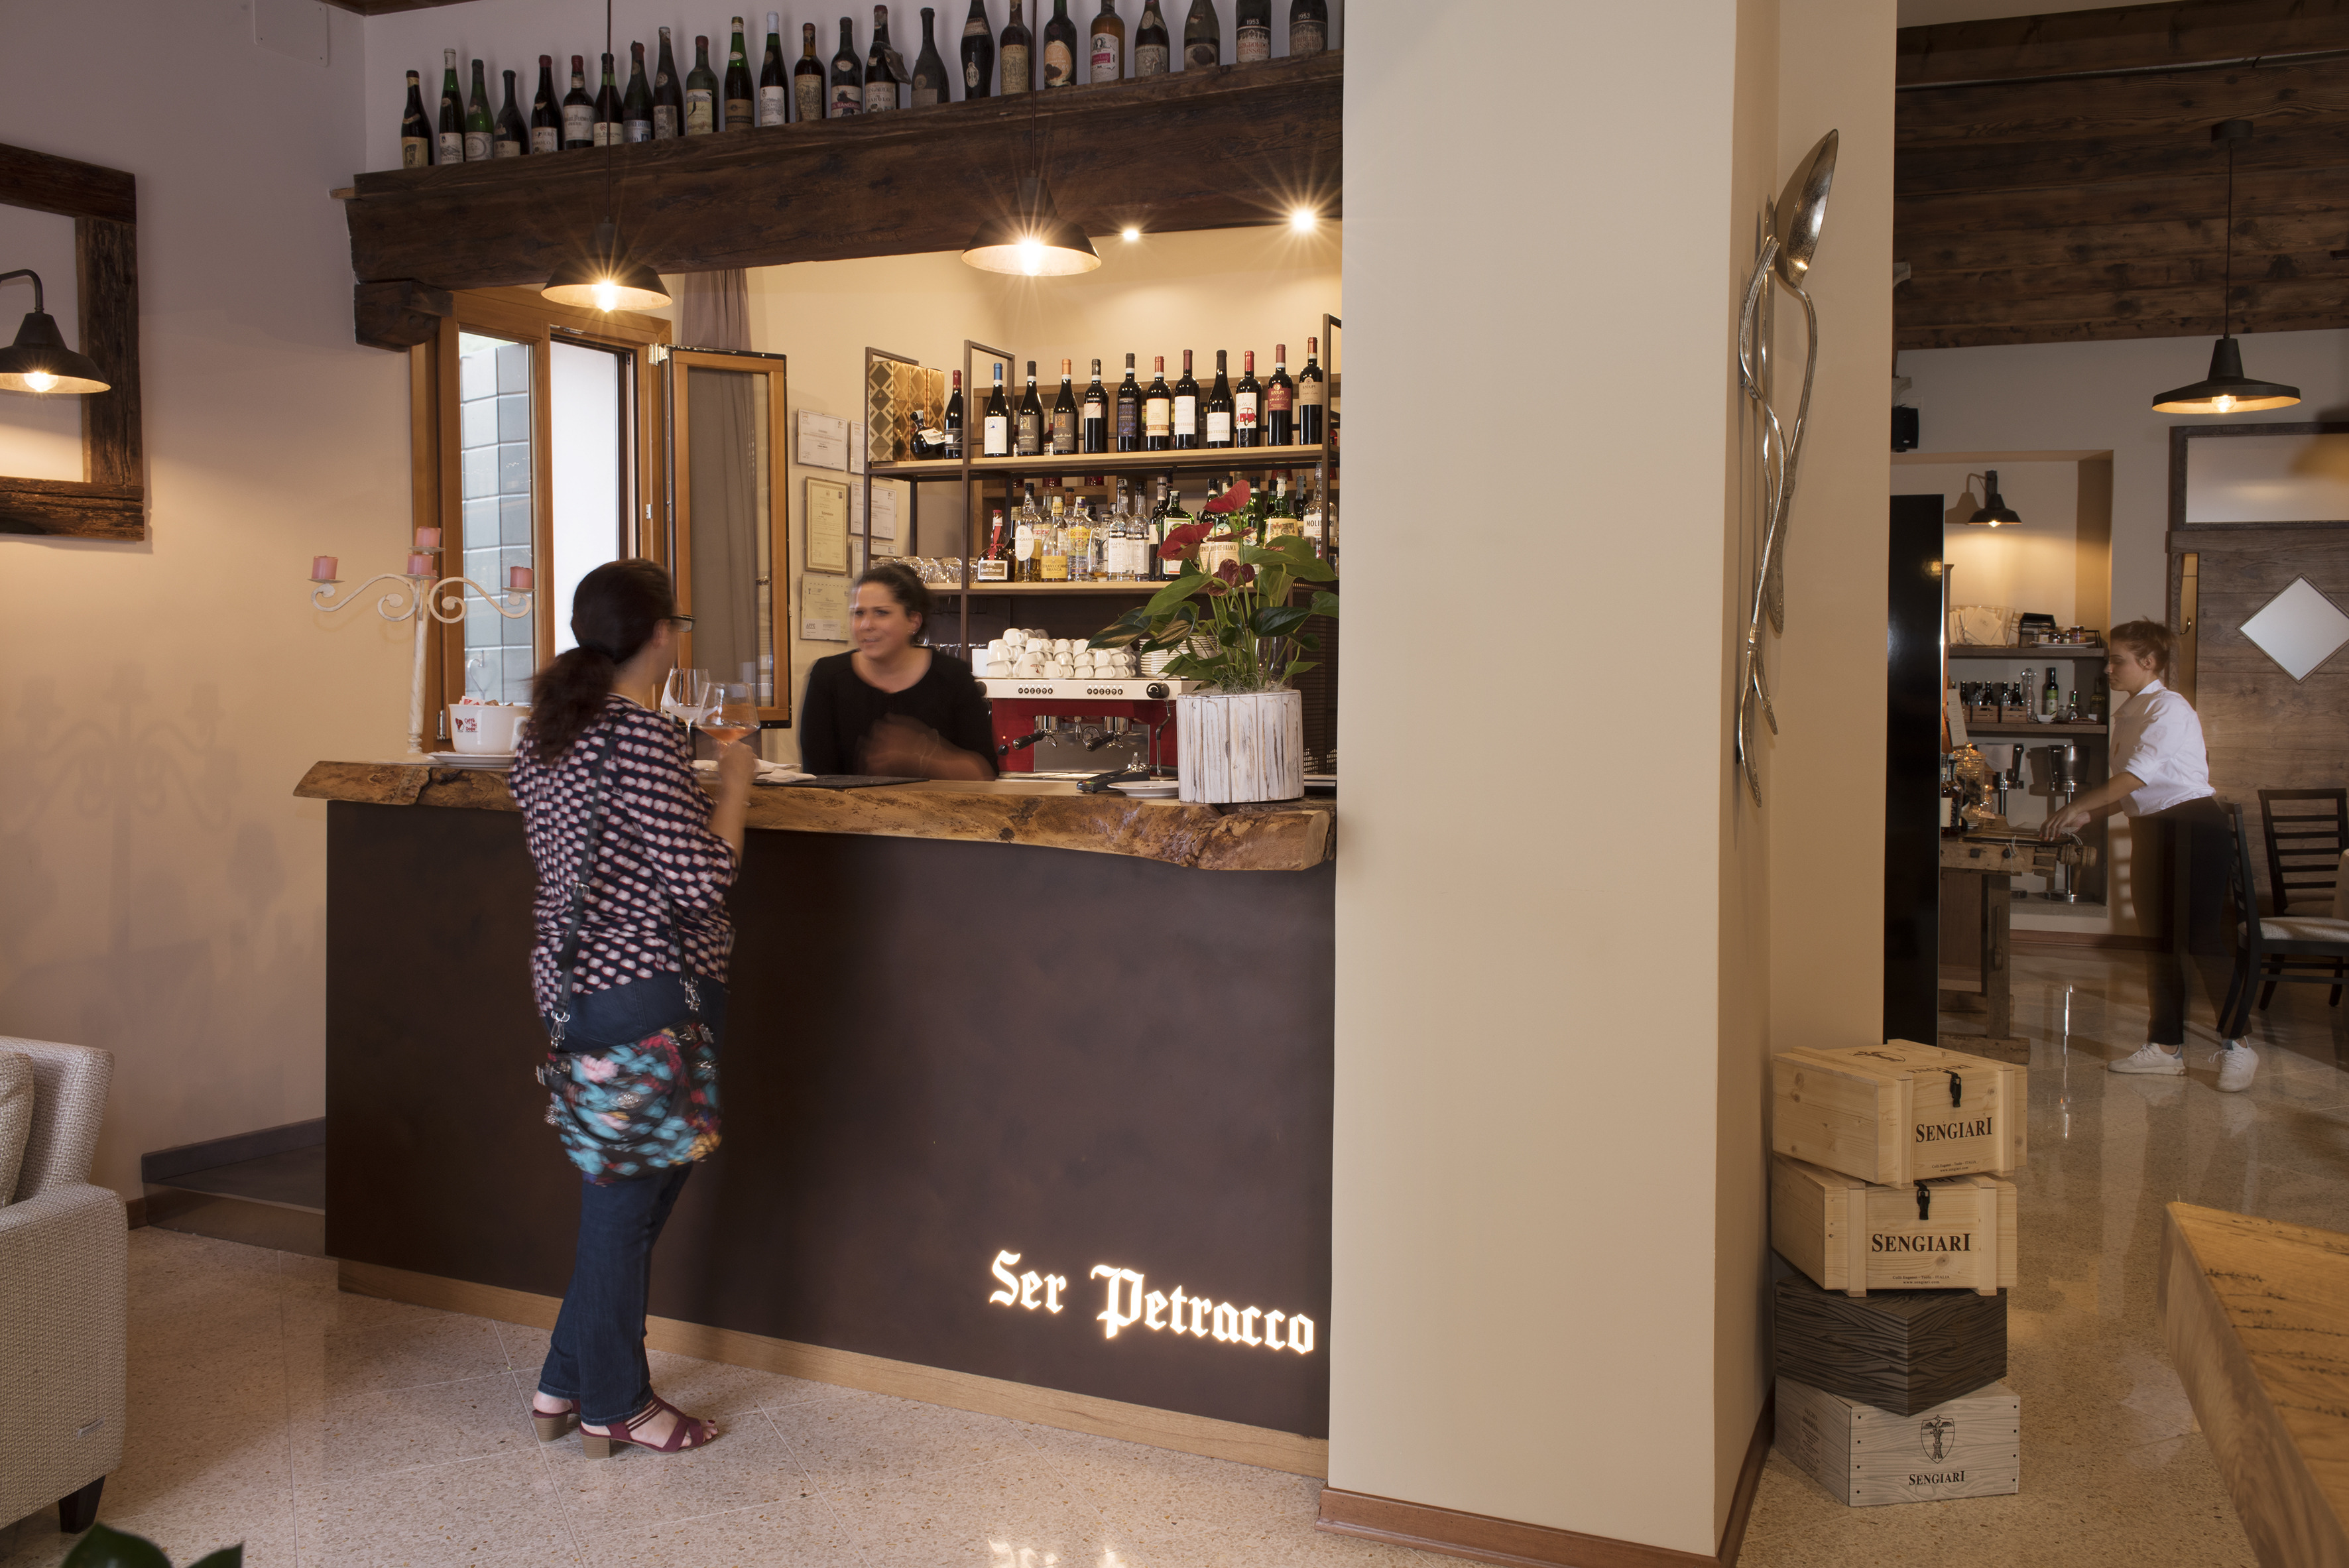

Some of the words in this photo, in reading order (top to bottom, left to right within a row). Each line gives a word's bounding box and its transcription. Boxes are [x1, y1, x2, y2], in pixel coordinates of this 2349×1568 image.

[1915, 1116, 1992, 1143] SENGIARI
[1872, 1233, 1971, 1252] SENGIARI
[989, 1249, 1067, 1314] Ser
[1091, 1264, 1314, 1355] Petracco
[1909, 1470, 1965, 1486] SENGIARI
